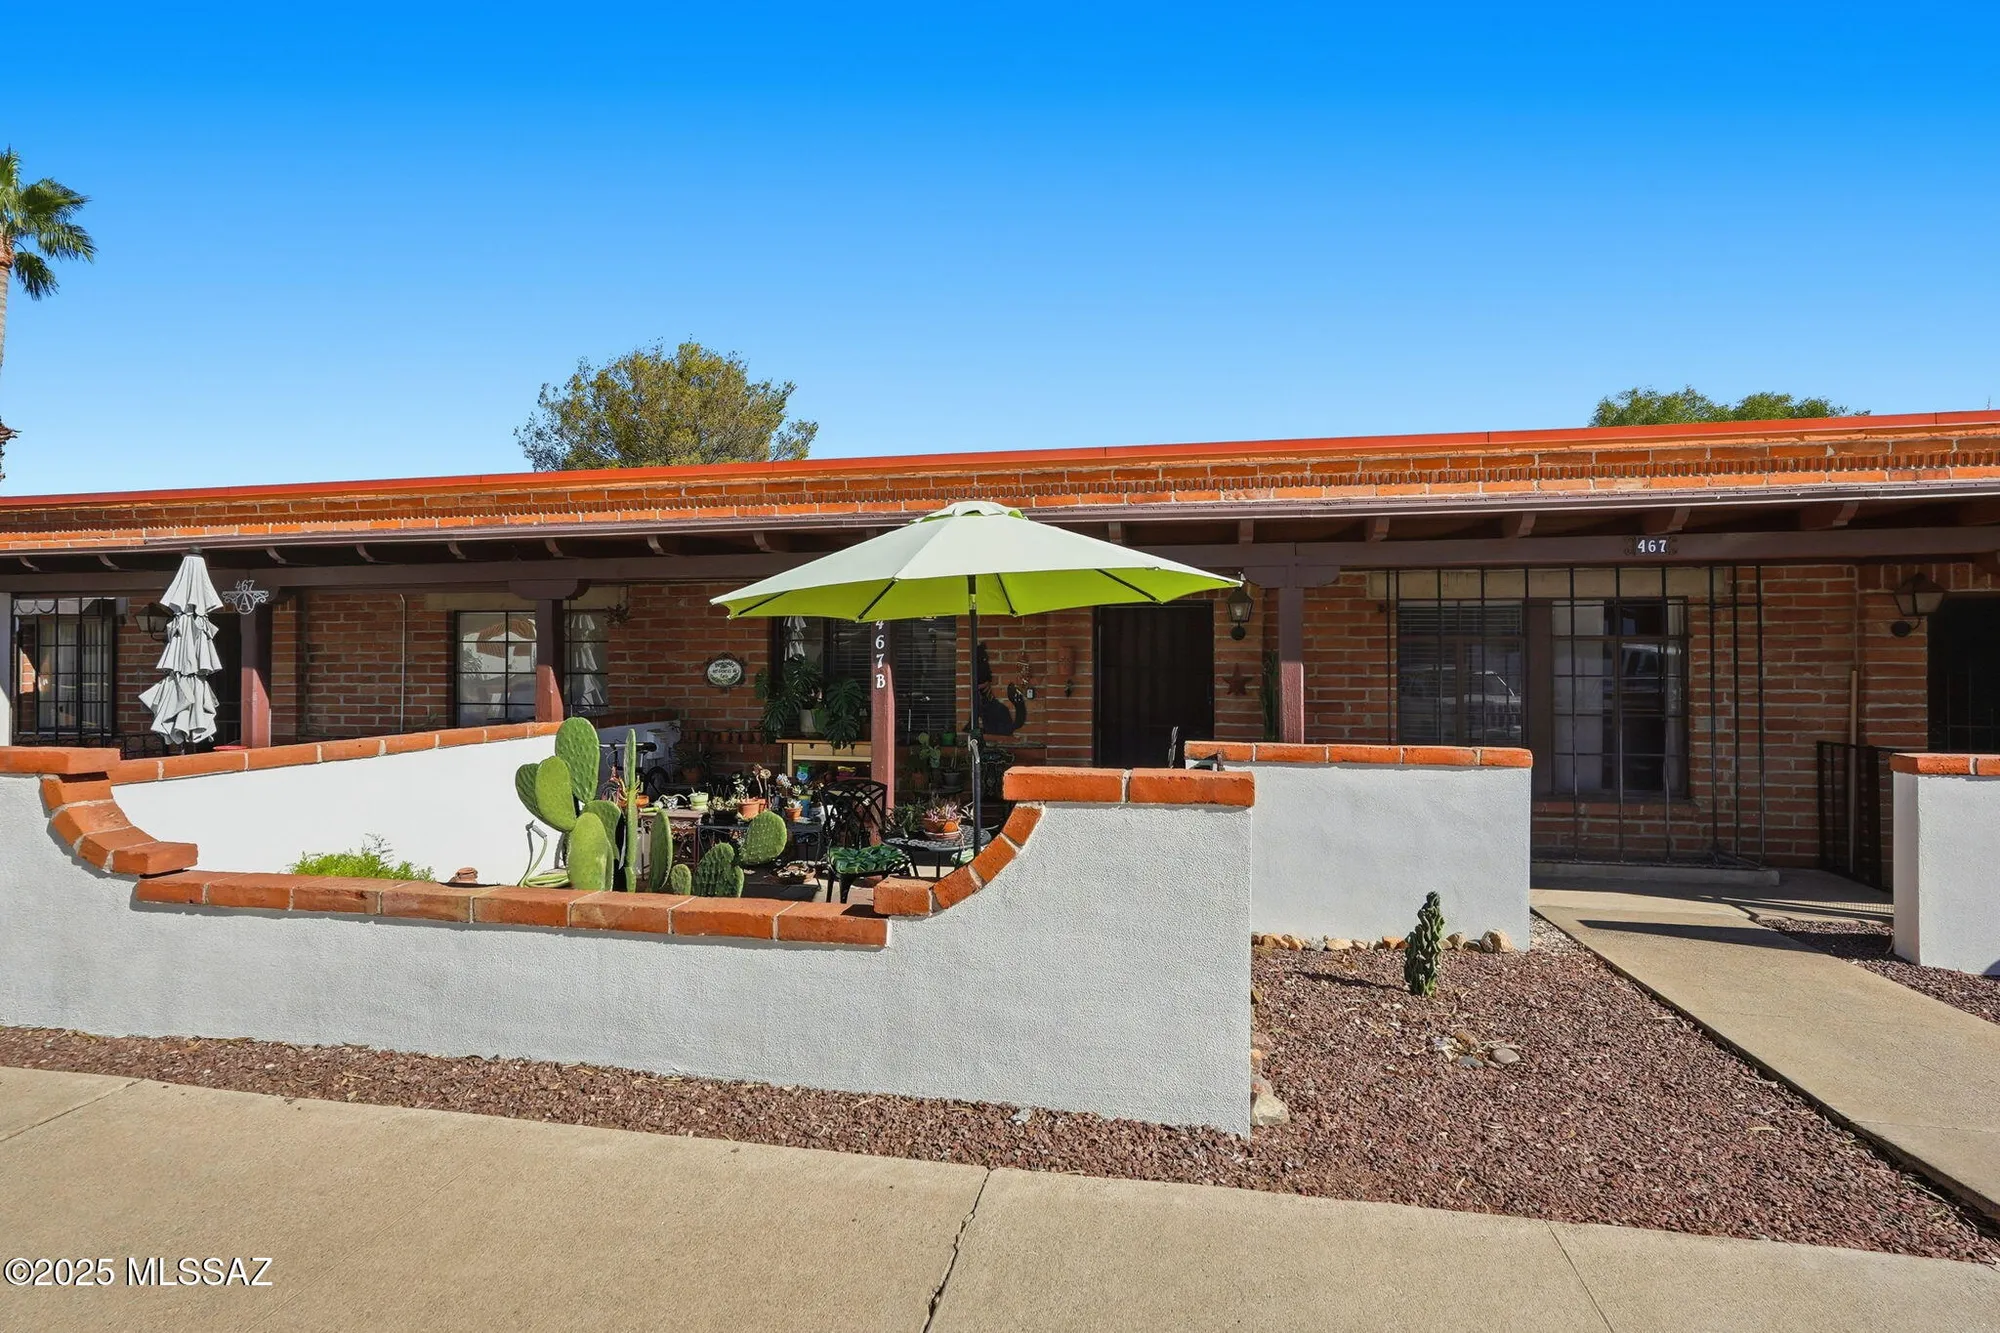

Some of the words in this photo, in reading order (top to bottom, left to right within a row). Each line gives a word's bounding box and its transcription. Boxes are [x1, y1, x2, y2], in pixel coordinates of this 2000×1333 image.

[1637, 539, 1667, 553] 467
[235, 579, 255, 592] 467
[240, 593, 251, 611] A
